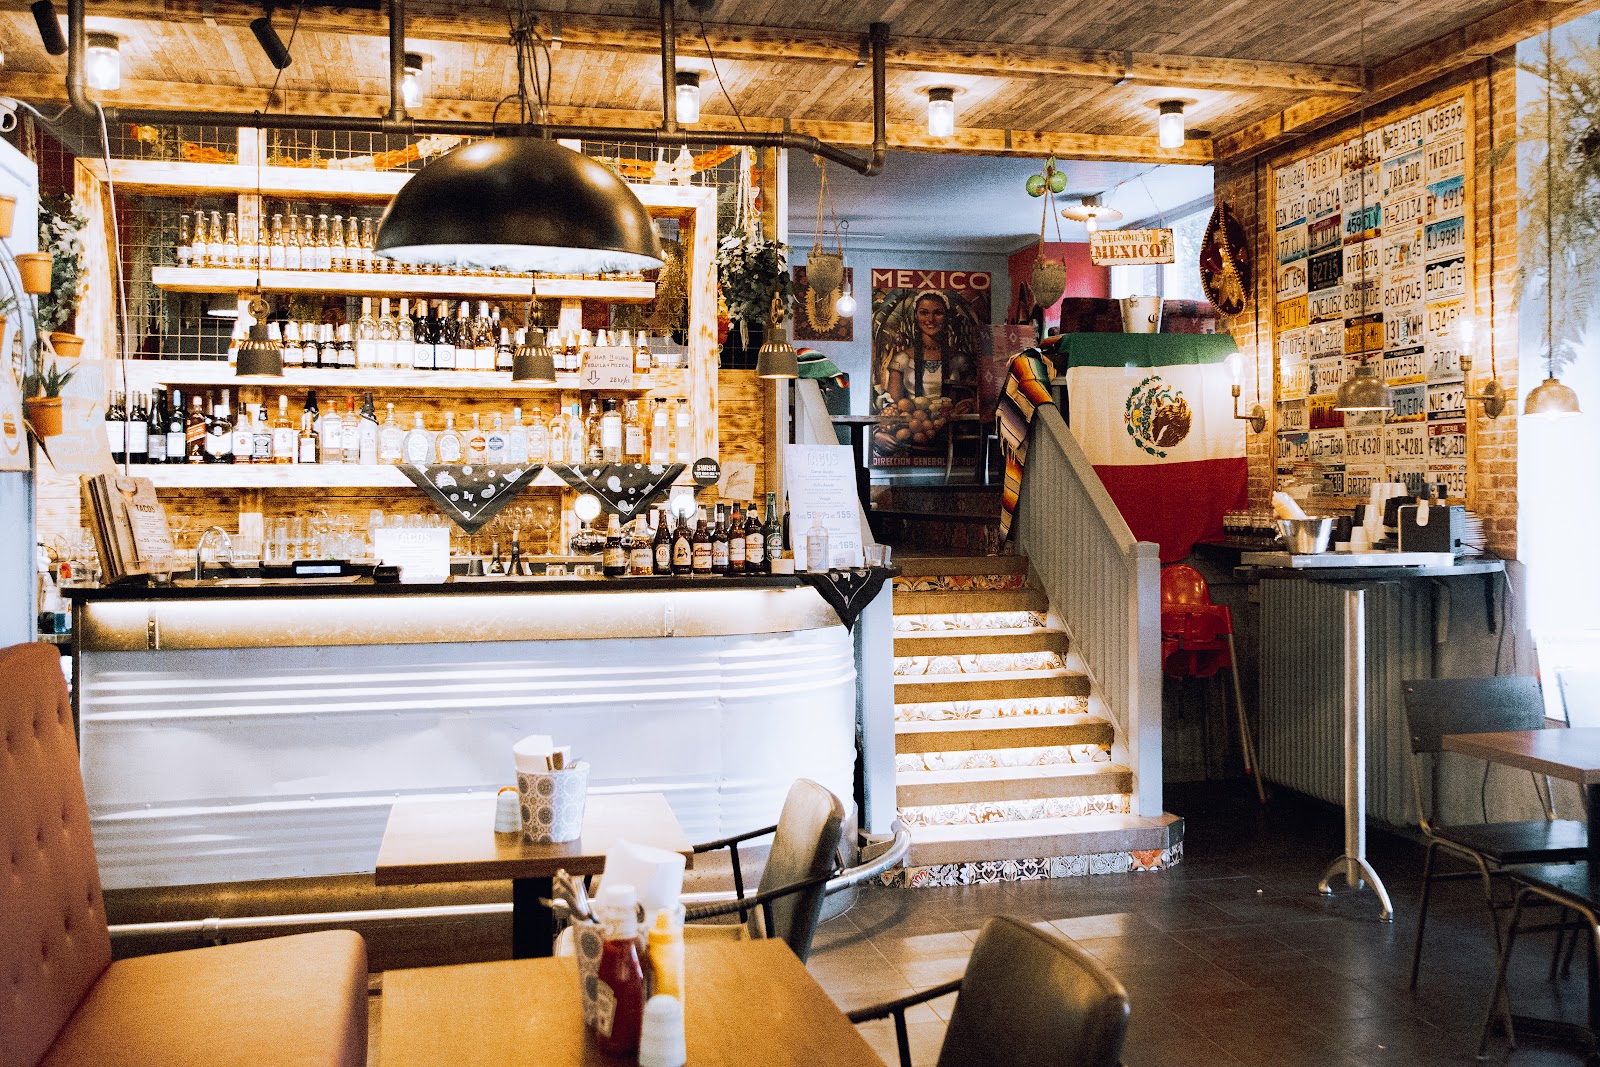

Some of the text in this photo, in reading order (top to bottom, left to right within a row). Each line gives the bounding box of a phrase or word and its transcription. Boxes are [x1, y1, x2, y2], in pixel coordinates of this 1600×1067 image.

[1101, 234, 1140, 244] WELCOME
[1094, 244, 1160, 259] MEXICO
[873, 270, 990, 290] MEXICO
[914, 457, 946, 466] GENERAL
